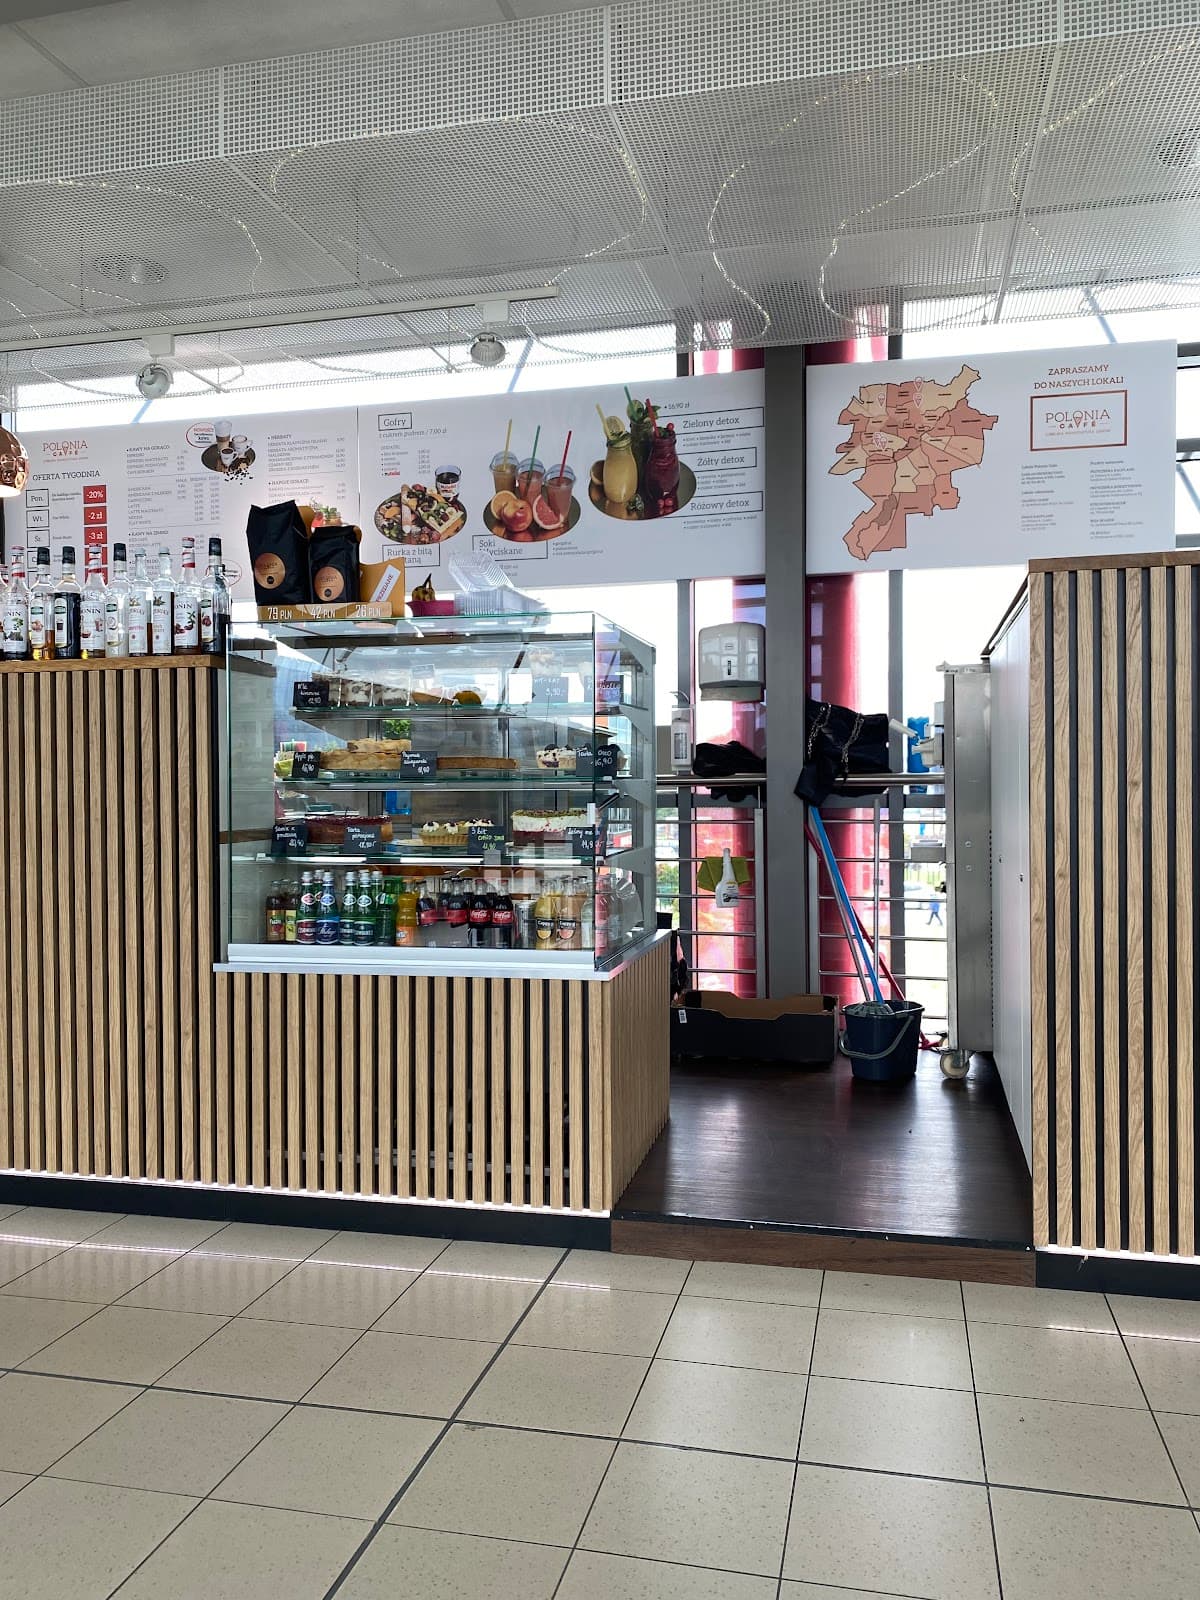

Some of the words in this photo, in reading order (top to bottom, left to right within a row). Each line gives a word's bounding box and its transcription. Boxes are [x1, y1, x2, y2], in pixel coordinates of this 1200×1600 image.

[1048, 364, 1109, 376] ZAPRASZAMY
[1048, 378, 1090, 388] NASZYCH
[1092, 376, 1124, 386] LOKALI
[384, 418, 406, 426] Gofry
[1046, 409, 1111, 424] POLONIA
[683, 419, 714, 429] Zielony
[716, 417, 740, 426] detox
[43, 440, 88, 452] POLONIA
[697, 456, 718, 466] Żółty
[721, 456, 744, 464] detox
[62, 470, 100, 479] TYGODNIA
[86, 490, 104, 499] -20%
[690, 502, 724, 511] Różowy
[726, 500, 750, 508] detox
[480, 540, 496, 548] Soki
[418, 547, 432, 556] bitą
[480, 548, 523, 556] yciskane
[268, 608, 278, 620] 79
[281, 610, 292, 619] PLN
[311, 608, 321, 619] 42
[324, 610, 336, 618] PLN
[356, 604, 366, 617] 26
